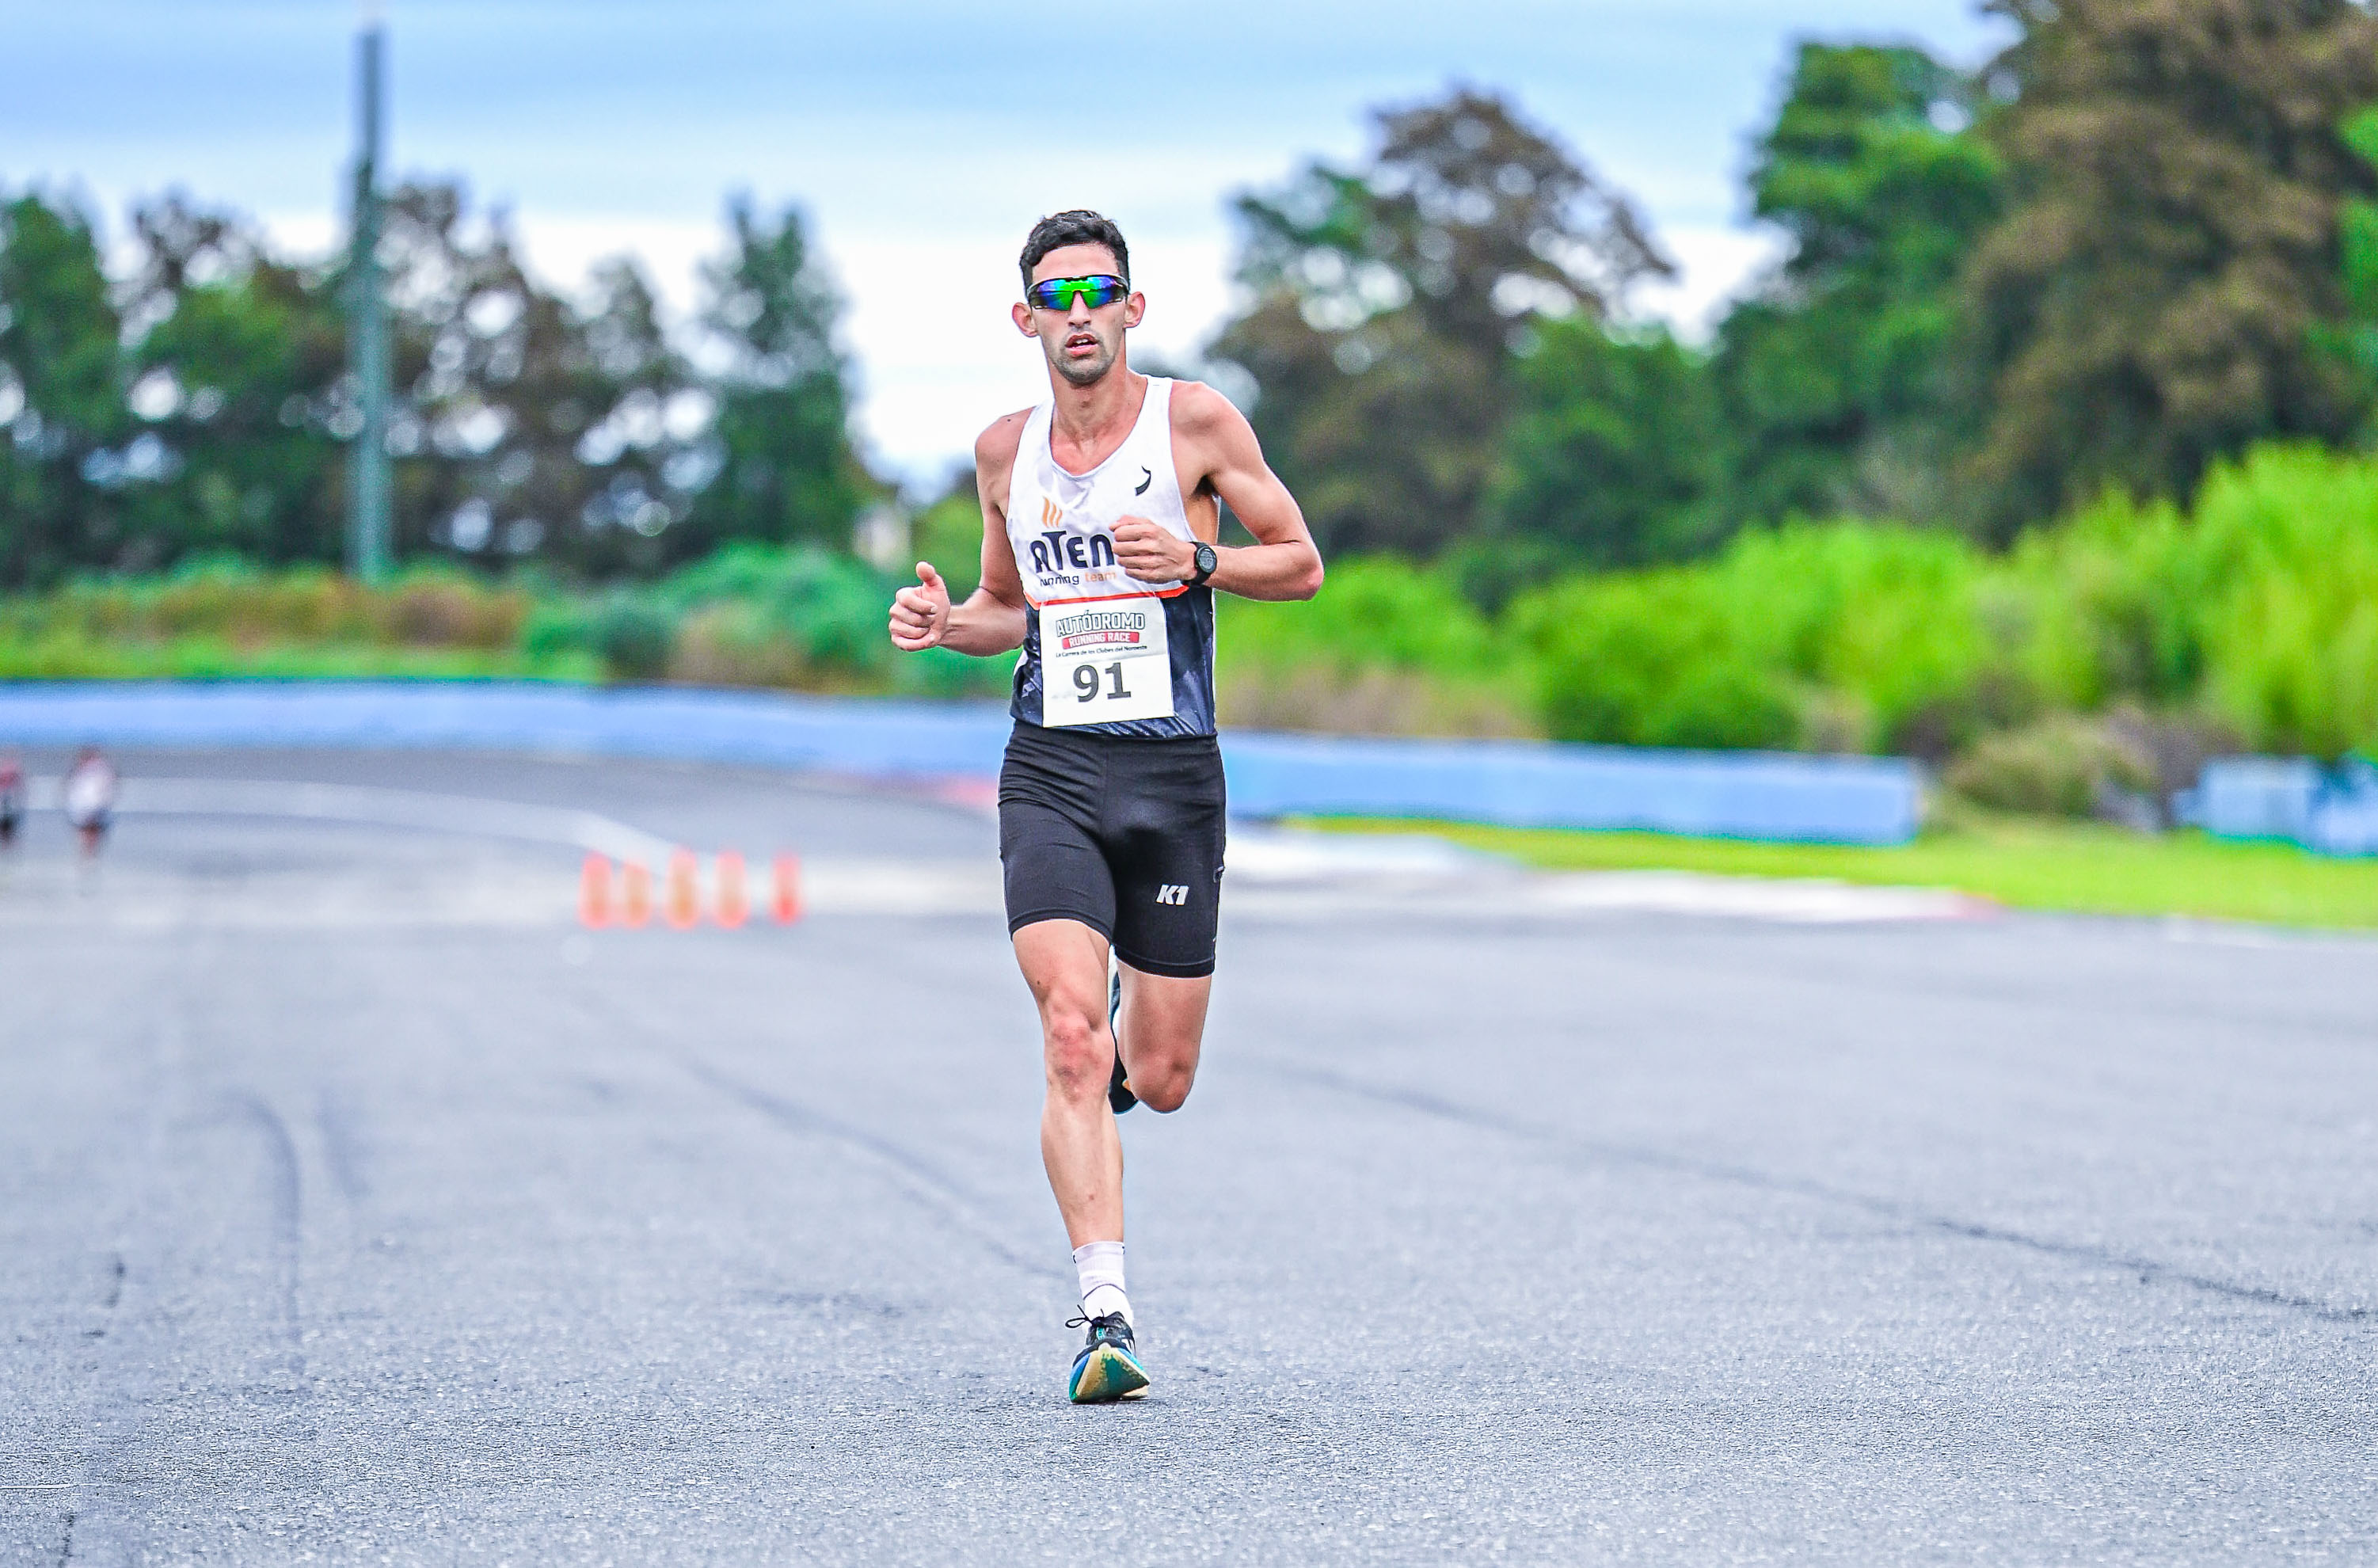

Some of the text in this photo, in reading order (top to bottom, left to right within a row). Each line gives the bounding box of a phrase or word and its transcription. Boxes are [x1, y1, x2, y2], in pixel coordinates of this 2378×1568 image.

[1029, 530, 1115, 573] ATEN
[1085, 572, 1117, 582] team
[1056, 609, 1145, 637] AUTÓDROMO
[1068, 632, 1131, 647] RUNNING RACE
[1073, 662, 1132, 702] 91
[1156, 885, 1189, 905] K1
